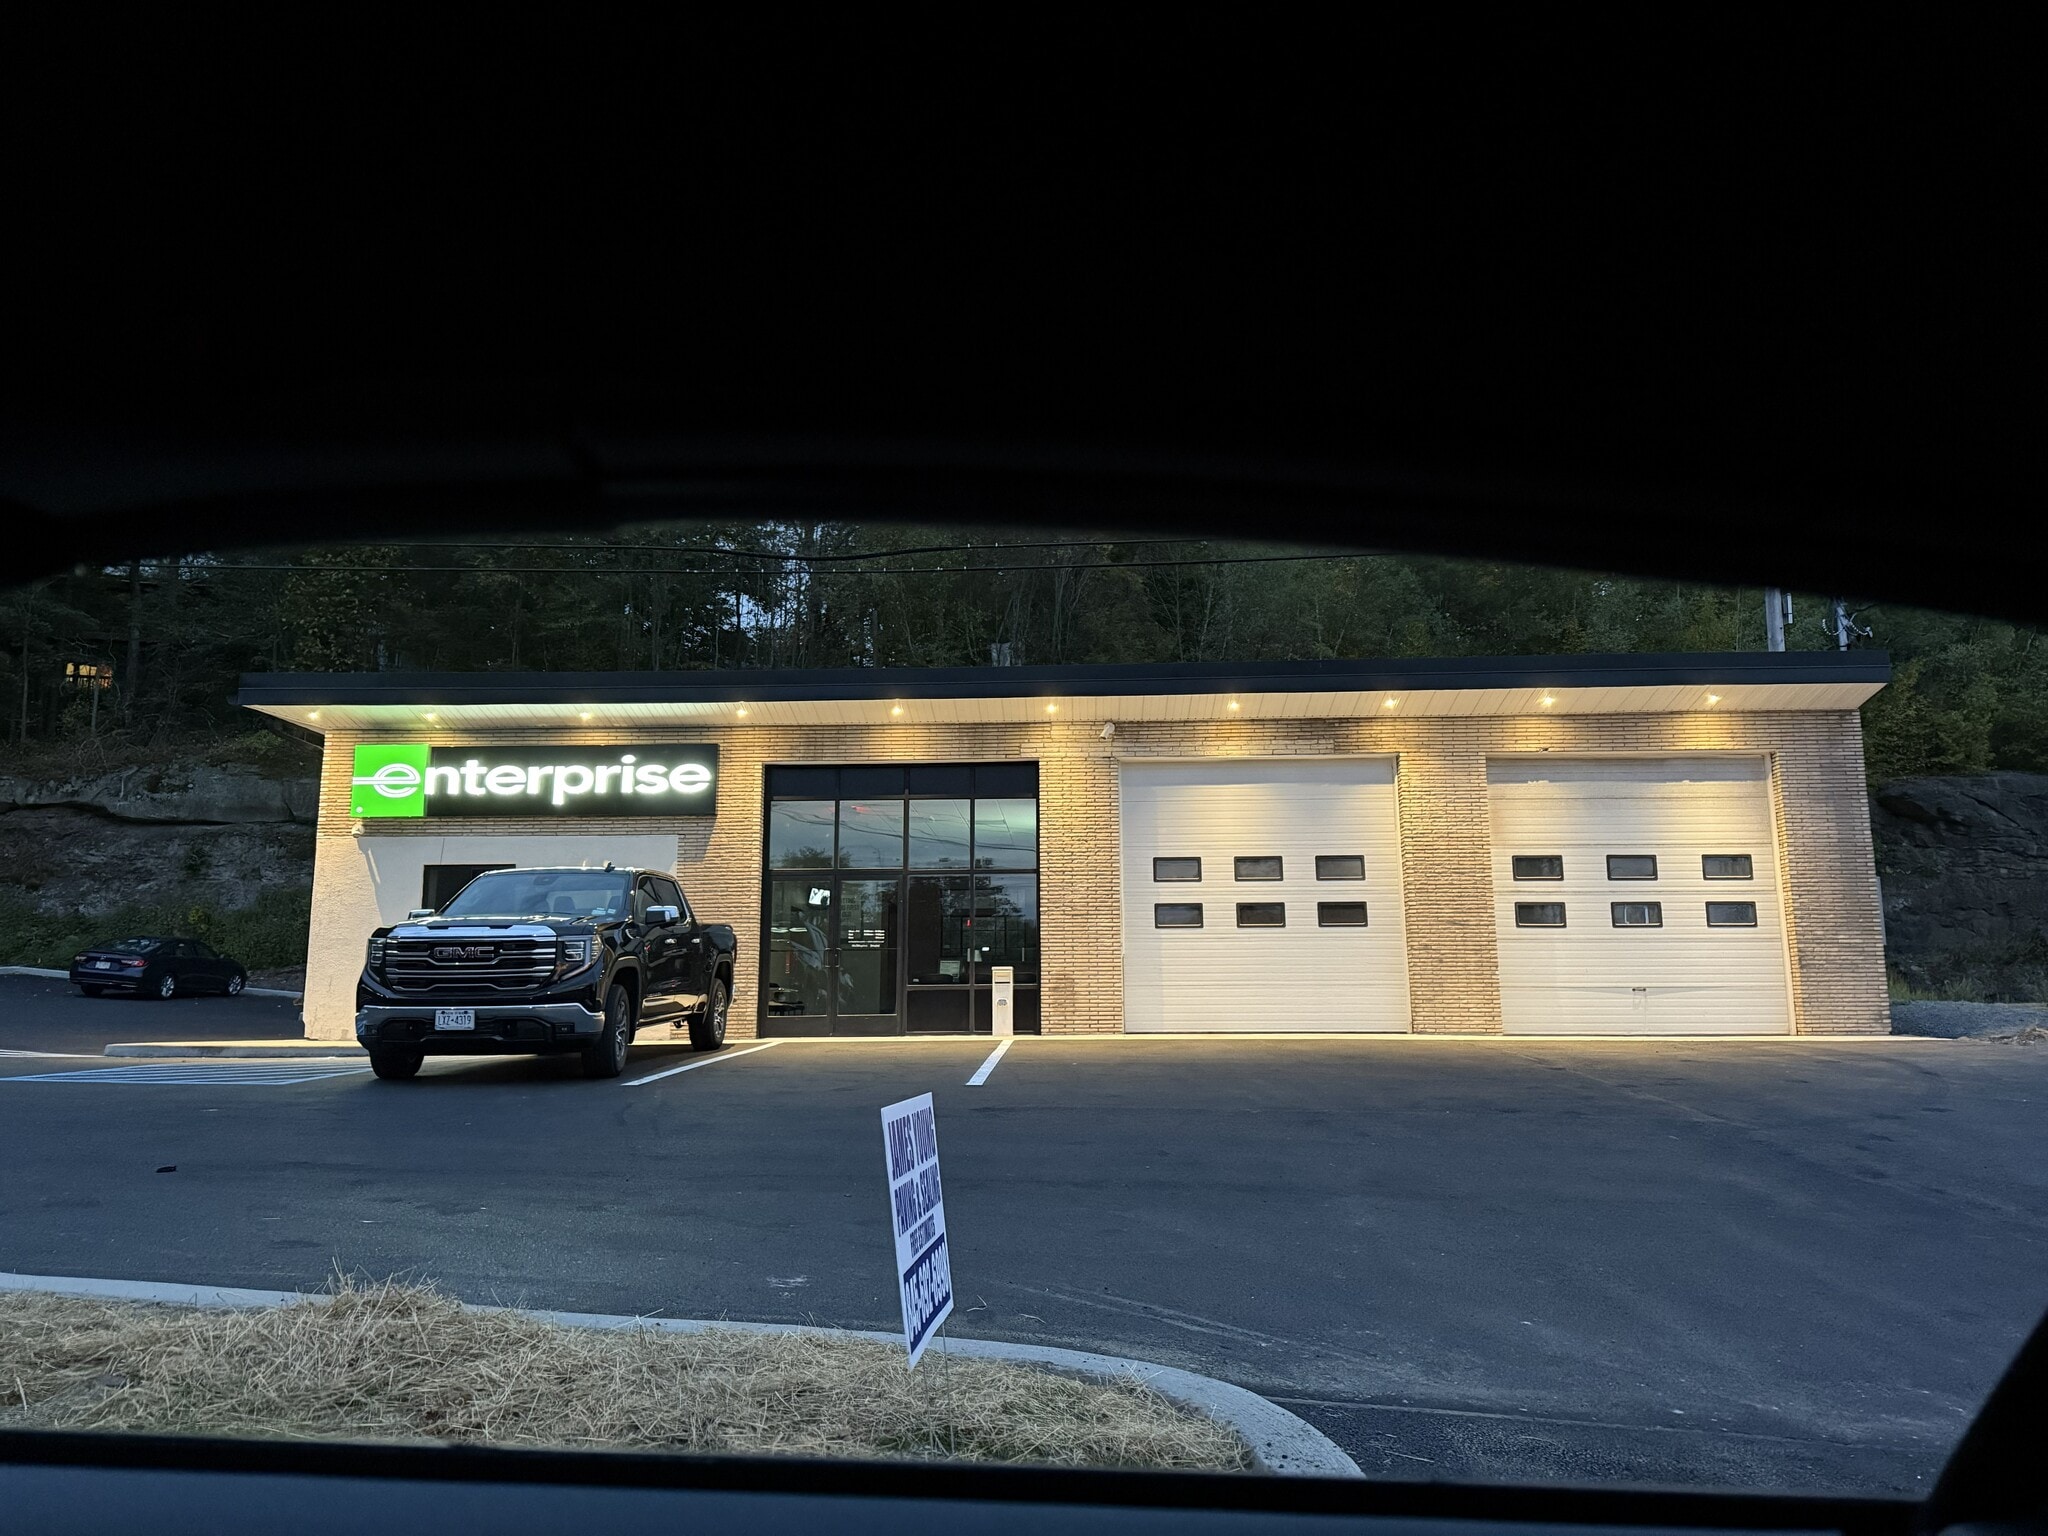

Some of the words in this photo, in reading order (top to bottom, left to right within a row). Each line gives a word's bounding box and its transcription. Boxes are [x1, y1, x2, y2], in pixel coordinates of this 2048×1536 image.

[352, 754, 712, 806] enterprise
[433, 946, 494, 959] GMC
[888, 1114, 915, 1181] JAMES
[911, 1106, 936, 1166] YOUNG
[894, 1177, 918, 1238] PAVING
[916, 1182, 923, 1220] &
